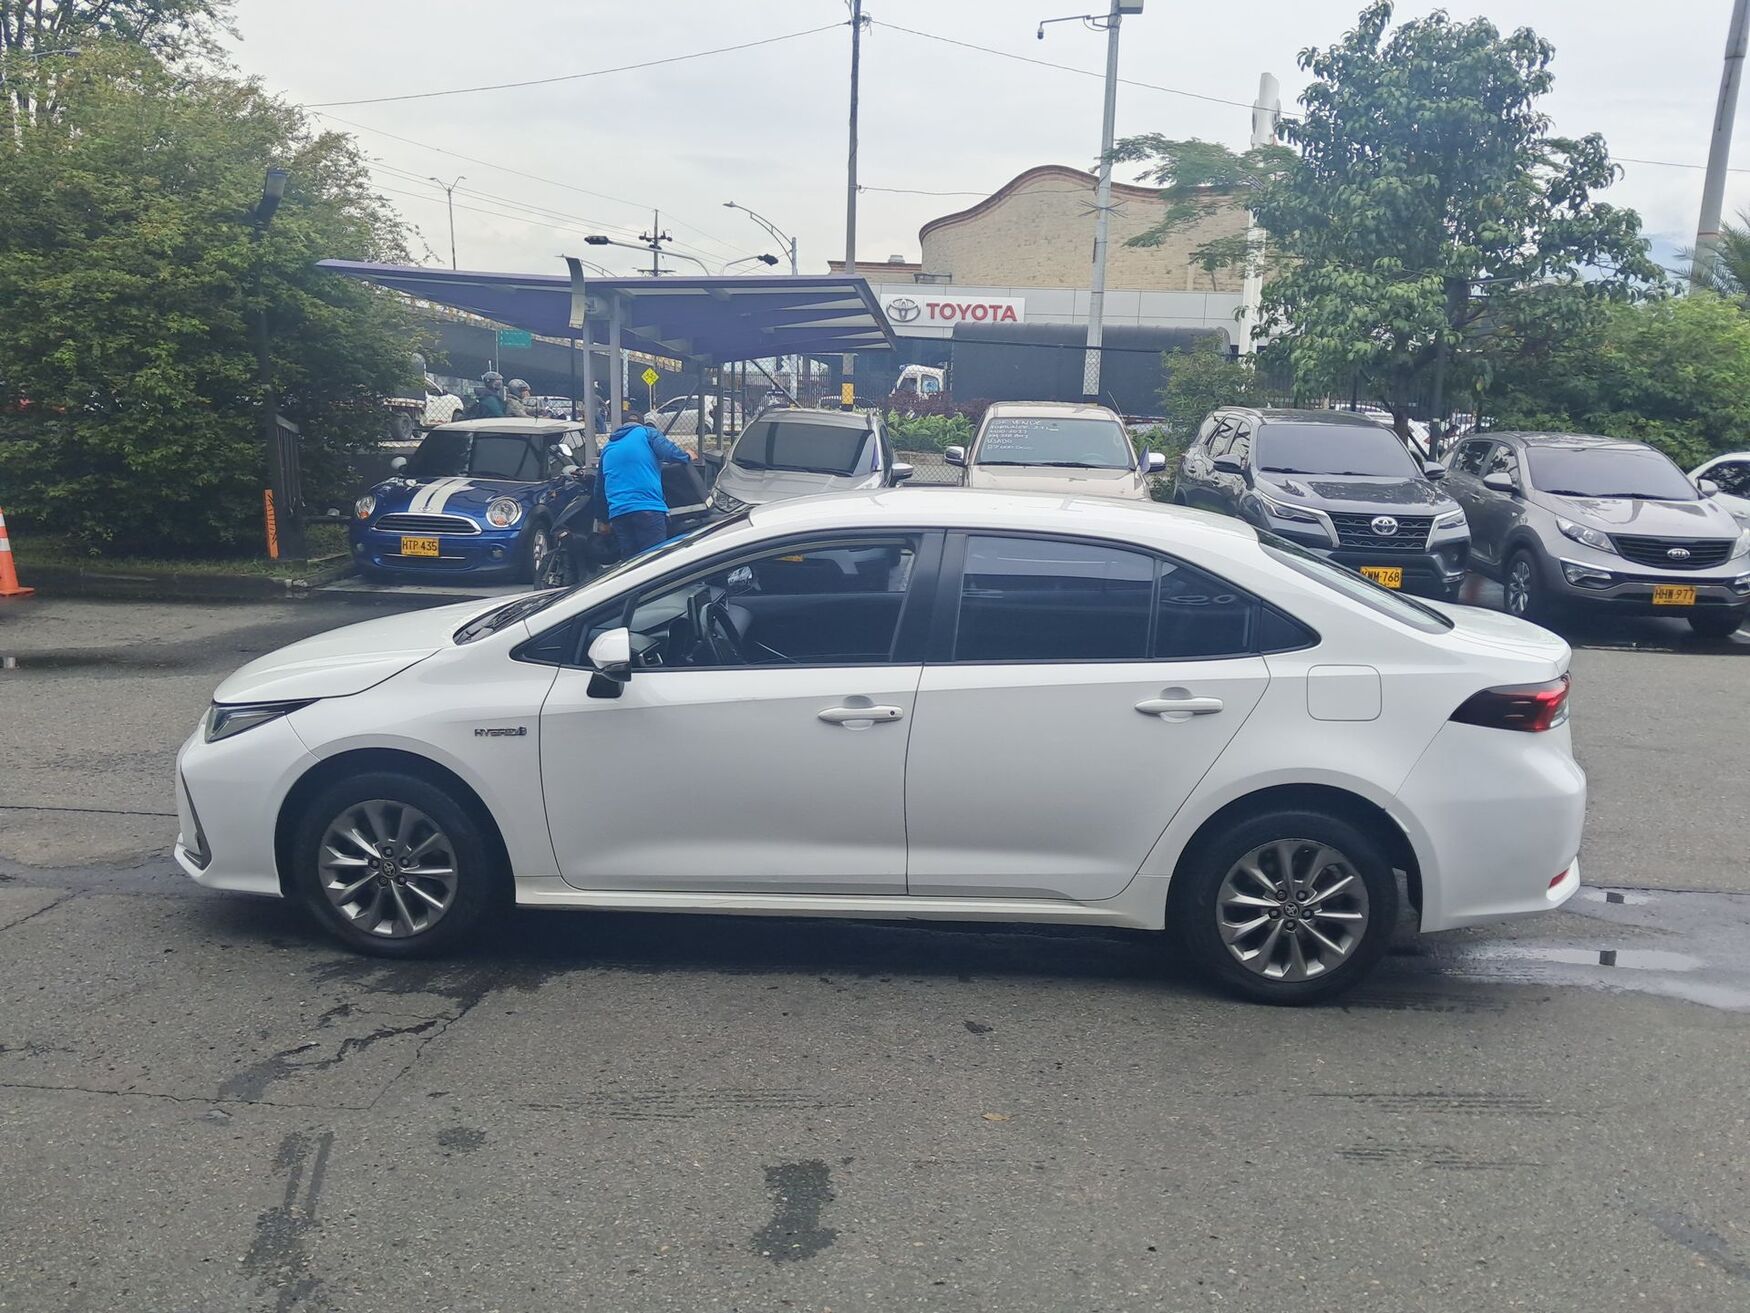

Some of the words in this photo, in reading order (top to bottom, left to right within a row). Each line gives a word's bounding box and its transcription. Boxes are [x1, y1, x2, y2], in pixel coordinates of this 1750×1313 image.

[926, 302, 1018, 322] TOYOTA
[402, 540, 419, 551] HTP
[420, 541, 438, 552] 435
